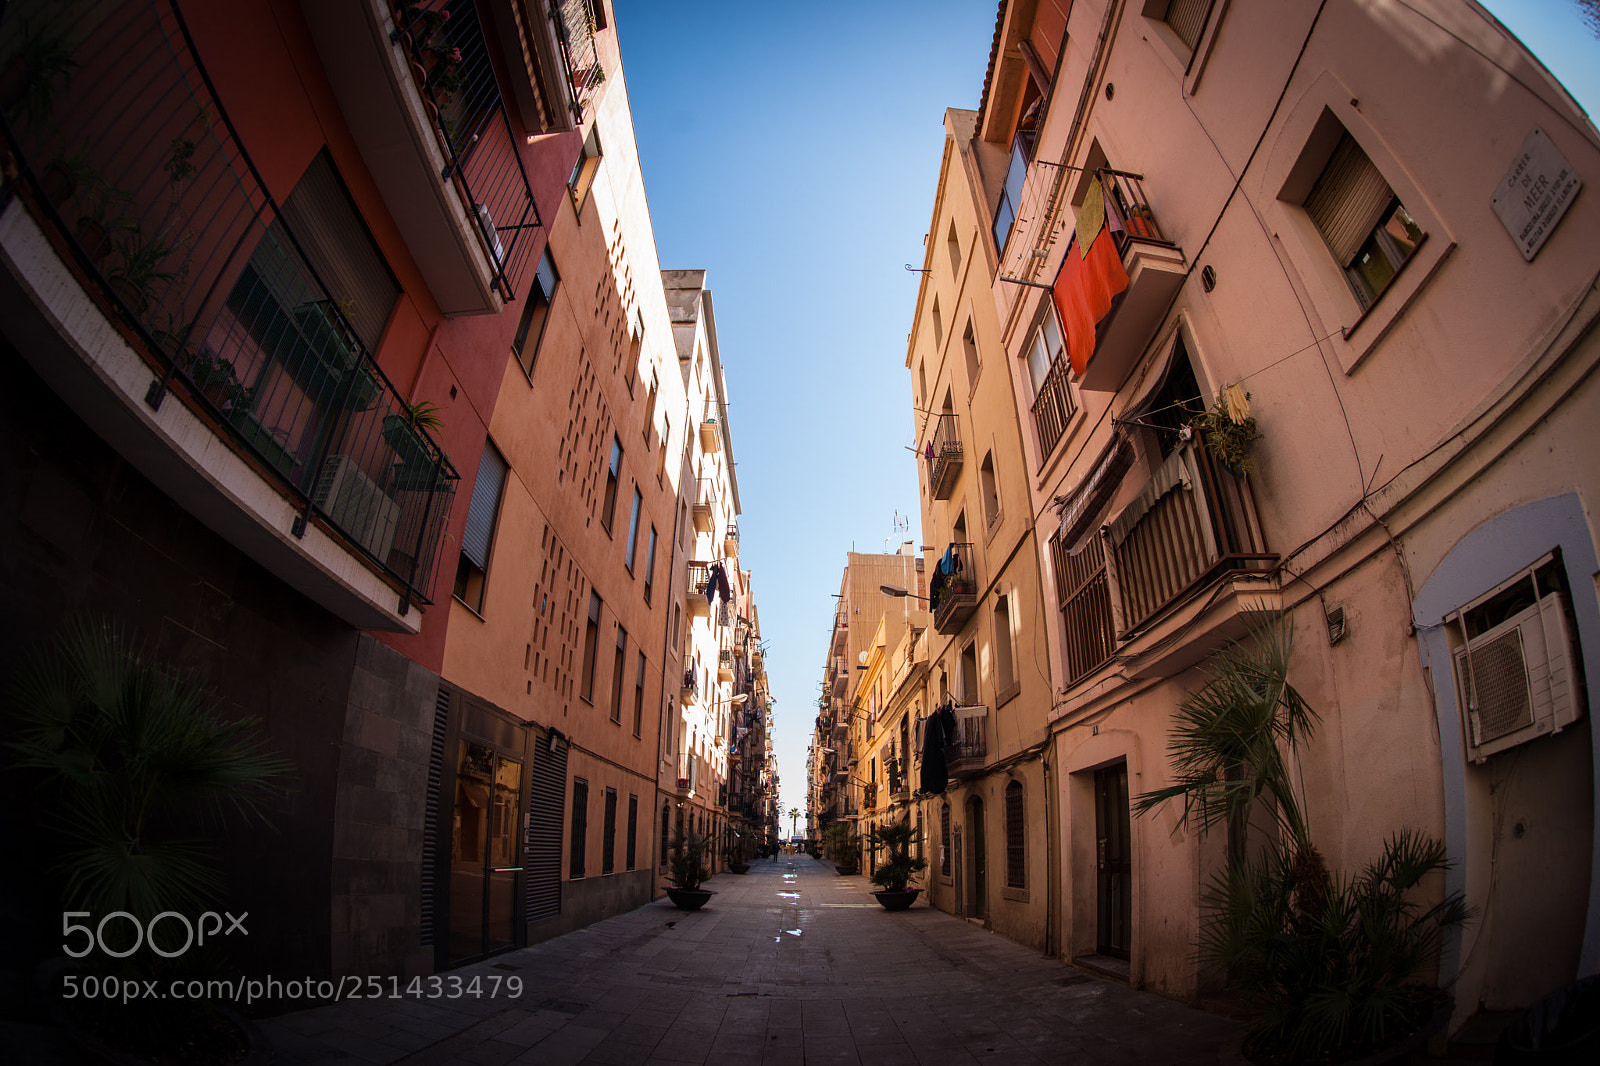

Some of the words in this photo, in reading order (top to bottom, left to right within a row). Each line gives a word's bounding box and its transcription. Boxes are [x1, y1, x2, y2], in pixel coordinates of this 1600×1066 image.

[1507, 152, 1531, 188] CARRER
[1521, 173, 1532, 189] DE
[1523, 173, 1549, 210] MEER
